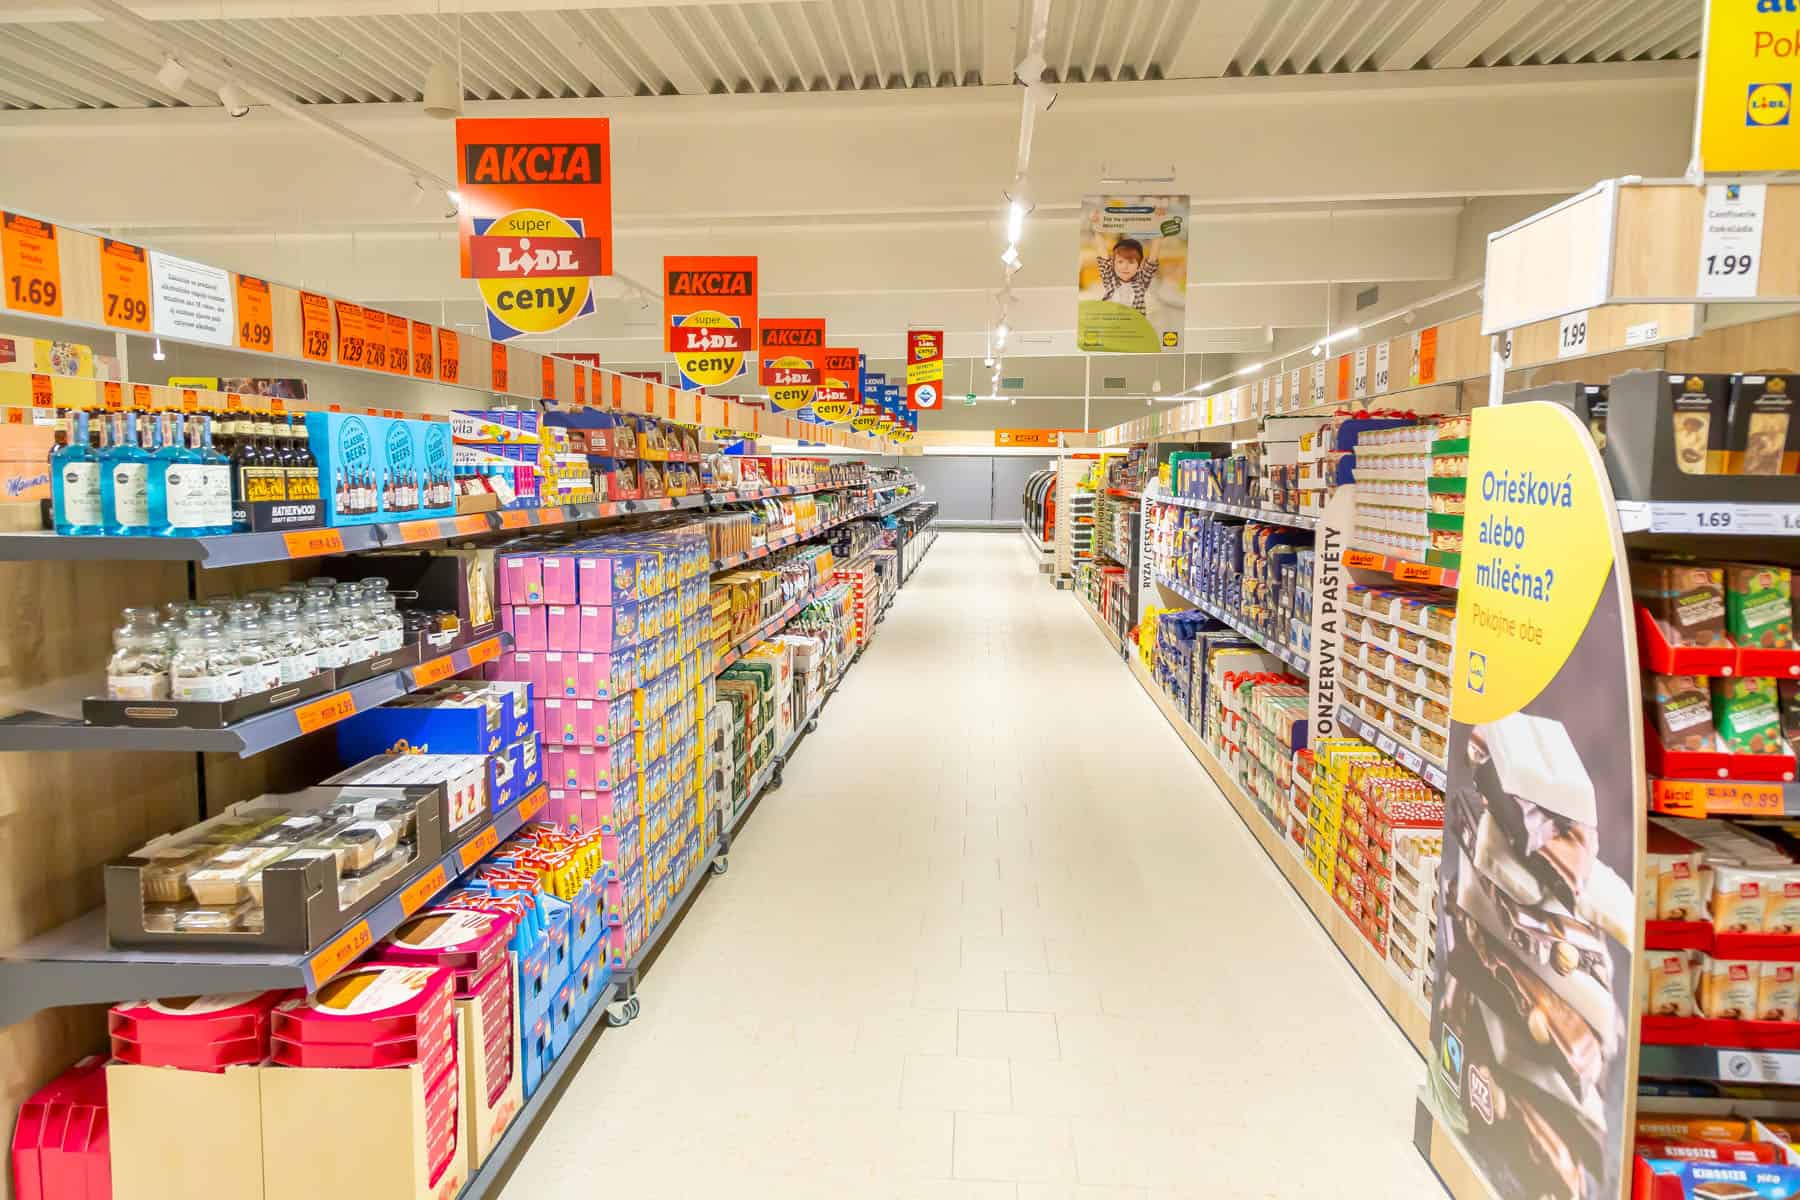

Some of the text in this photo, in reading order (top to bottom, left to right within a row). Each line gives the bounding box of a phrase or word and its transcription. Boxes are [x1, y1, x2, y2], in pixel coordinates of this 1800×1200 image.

[475, 147, 592, 182] AKCIA
[509, 218, 551, 233] super
[1706, 254, 1752, 276] 1.99
[11, 275, 57, 307] 1.69
[674, 273, 746, 295] AKCIA
[107, 293, 147, 323] 7.99
[497, 286, 576, 314] ceny
[694, 316, 721, 325] super
[242, 321, 271, 345] 4.99
[767, 330, 817, 345] AKCIA
[1563, 322, 1586, 347] 1.99
[308, 338, 328, 356] 1.29
[343, 344, 362, 361] 1.29
[686, 356, 735, 373] ceny
[774, 390, 809, 401] ceny
[817, 404, 845, 414] ceny
[345, 444, 366, 462] BEERS
[1482, 471, 1572, 508] Oriešková
[1696, 512, 1731, 527] 1.69
[1479, 514, 1525, 550] alebo
[1476, 557, 1554, 603] mliečna?
[1317, 527, 1341, 739] ONZERVY A PAŠTÉTY
[1472, 603, 1543, 645] Pokojne obe
[1692, 1167, 1748, 1181] KINGSIZE
